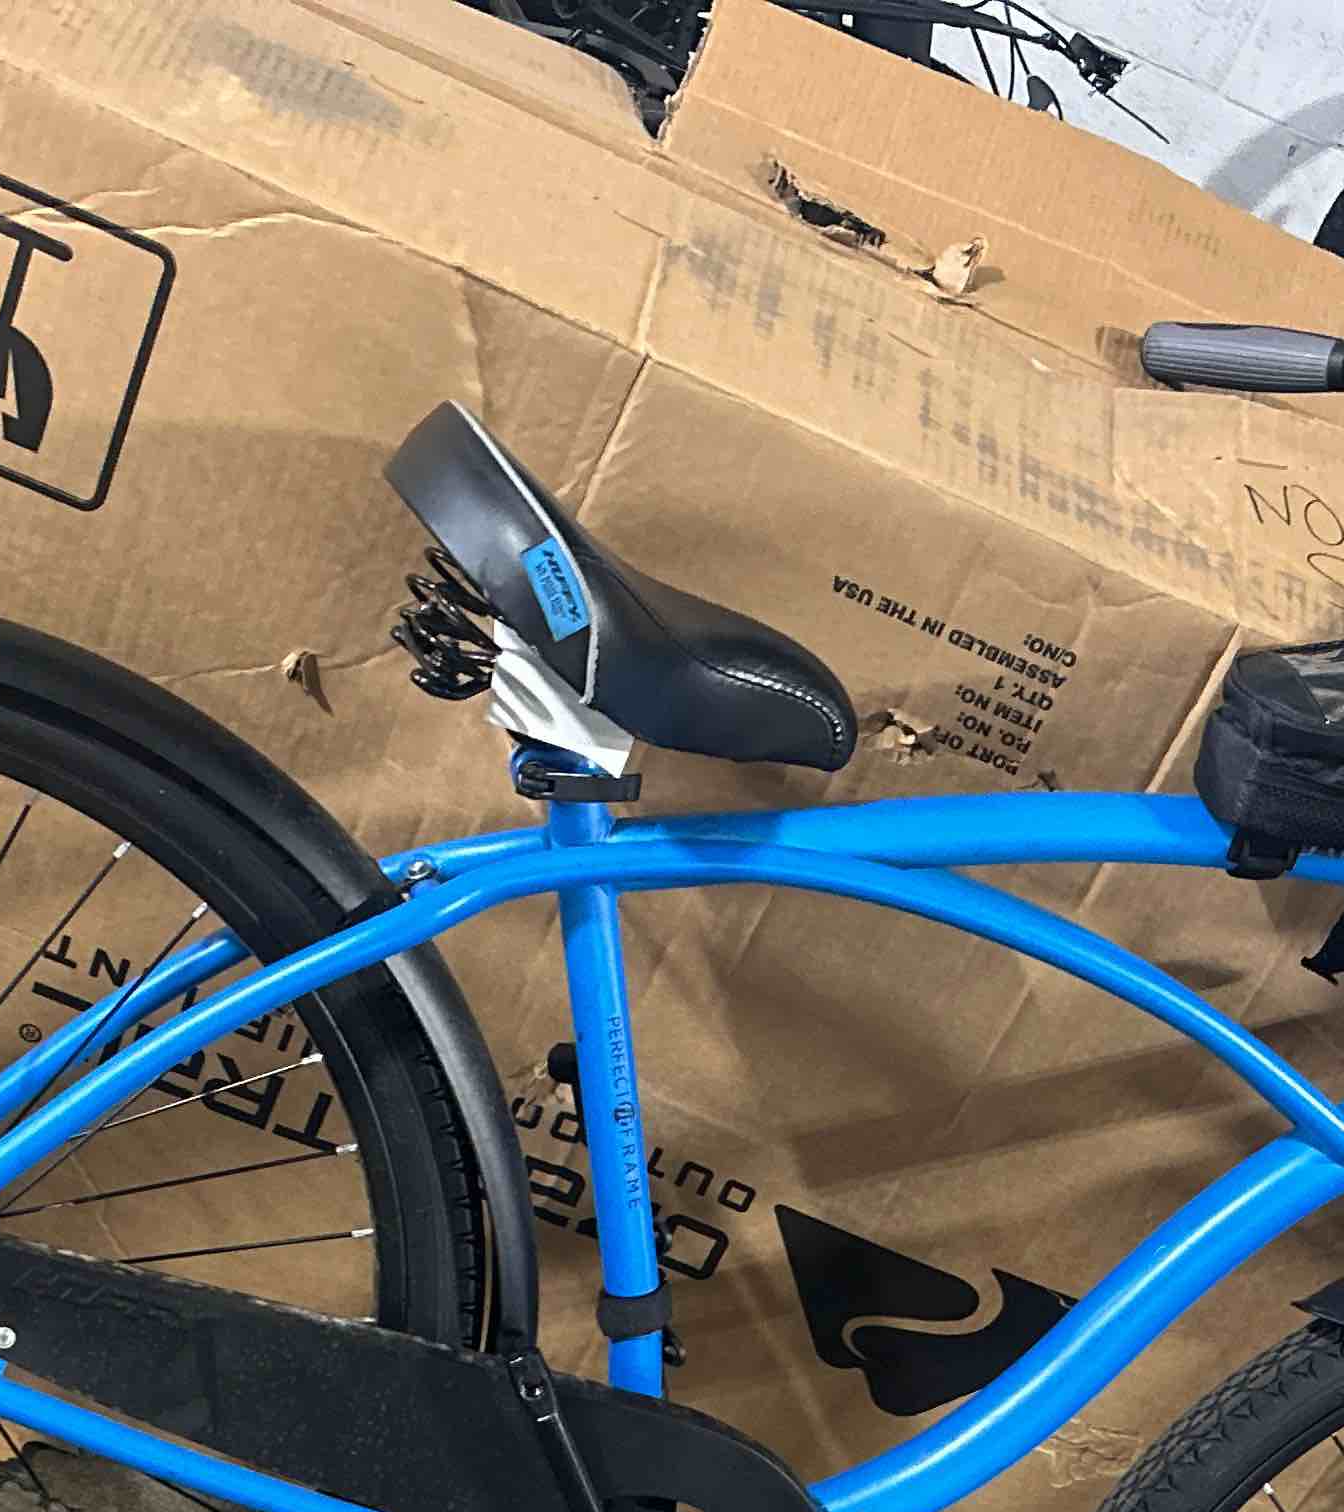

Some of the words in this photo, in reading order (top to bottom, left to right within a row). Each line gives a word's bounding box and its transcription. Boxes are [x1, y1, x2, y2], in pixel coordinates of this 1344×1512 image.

[1244, 484, 1344, 546] NO
[832, 576, 874, 606] USA
[876, 596, 917, 626] THE
[920, 616, 946, 637] IN
[948, 628, 1067, 689] ASSEMBLED
[1023, 633, 1077, 668] C/NO:
[955, 684, 991, 710] NO:
[993, 675, 1004, 690] 1
[1012, 682, 1054, 711] QTY.
[957, 712, 992, 737] NO:
[993, 703, 1044, 733] ITEM
[966, 742, 1018, 776] PORT
[607, 1016, 631, 1098] PERFECT
[621, 1128, 642, 1210] FRAME
